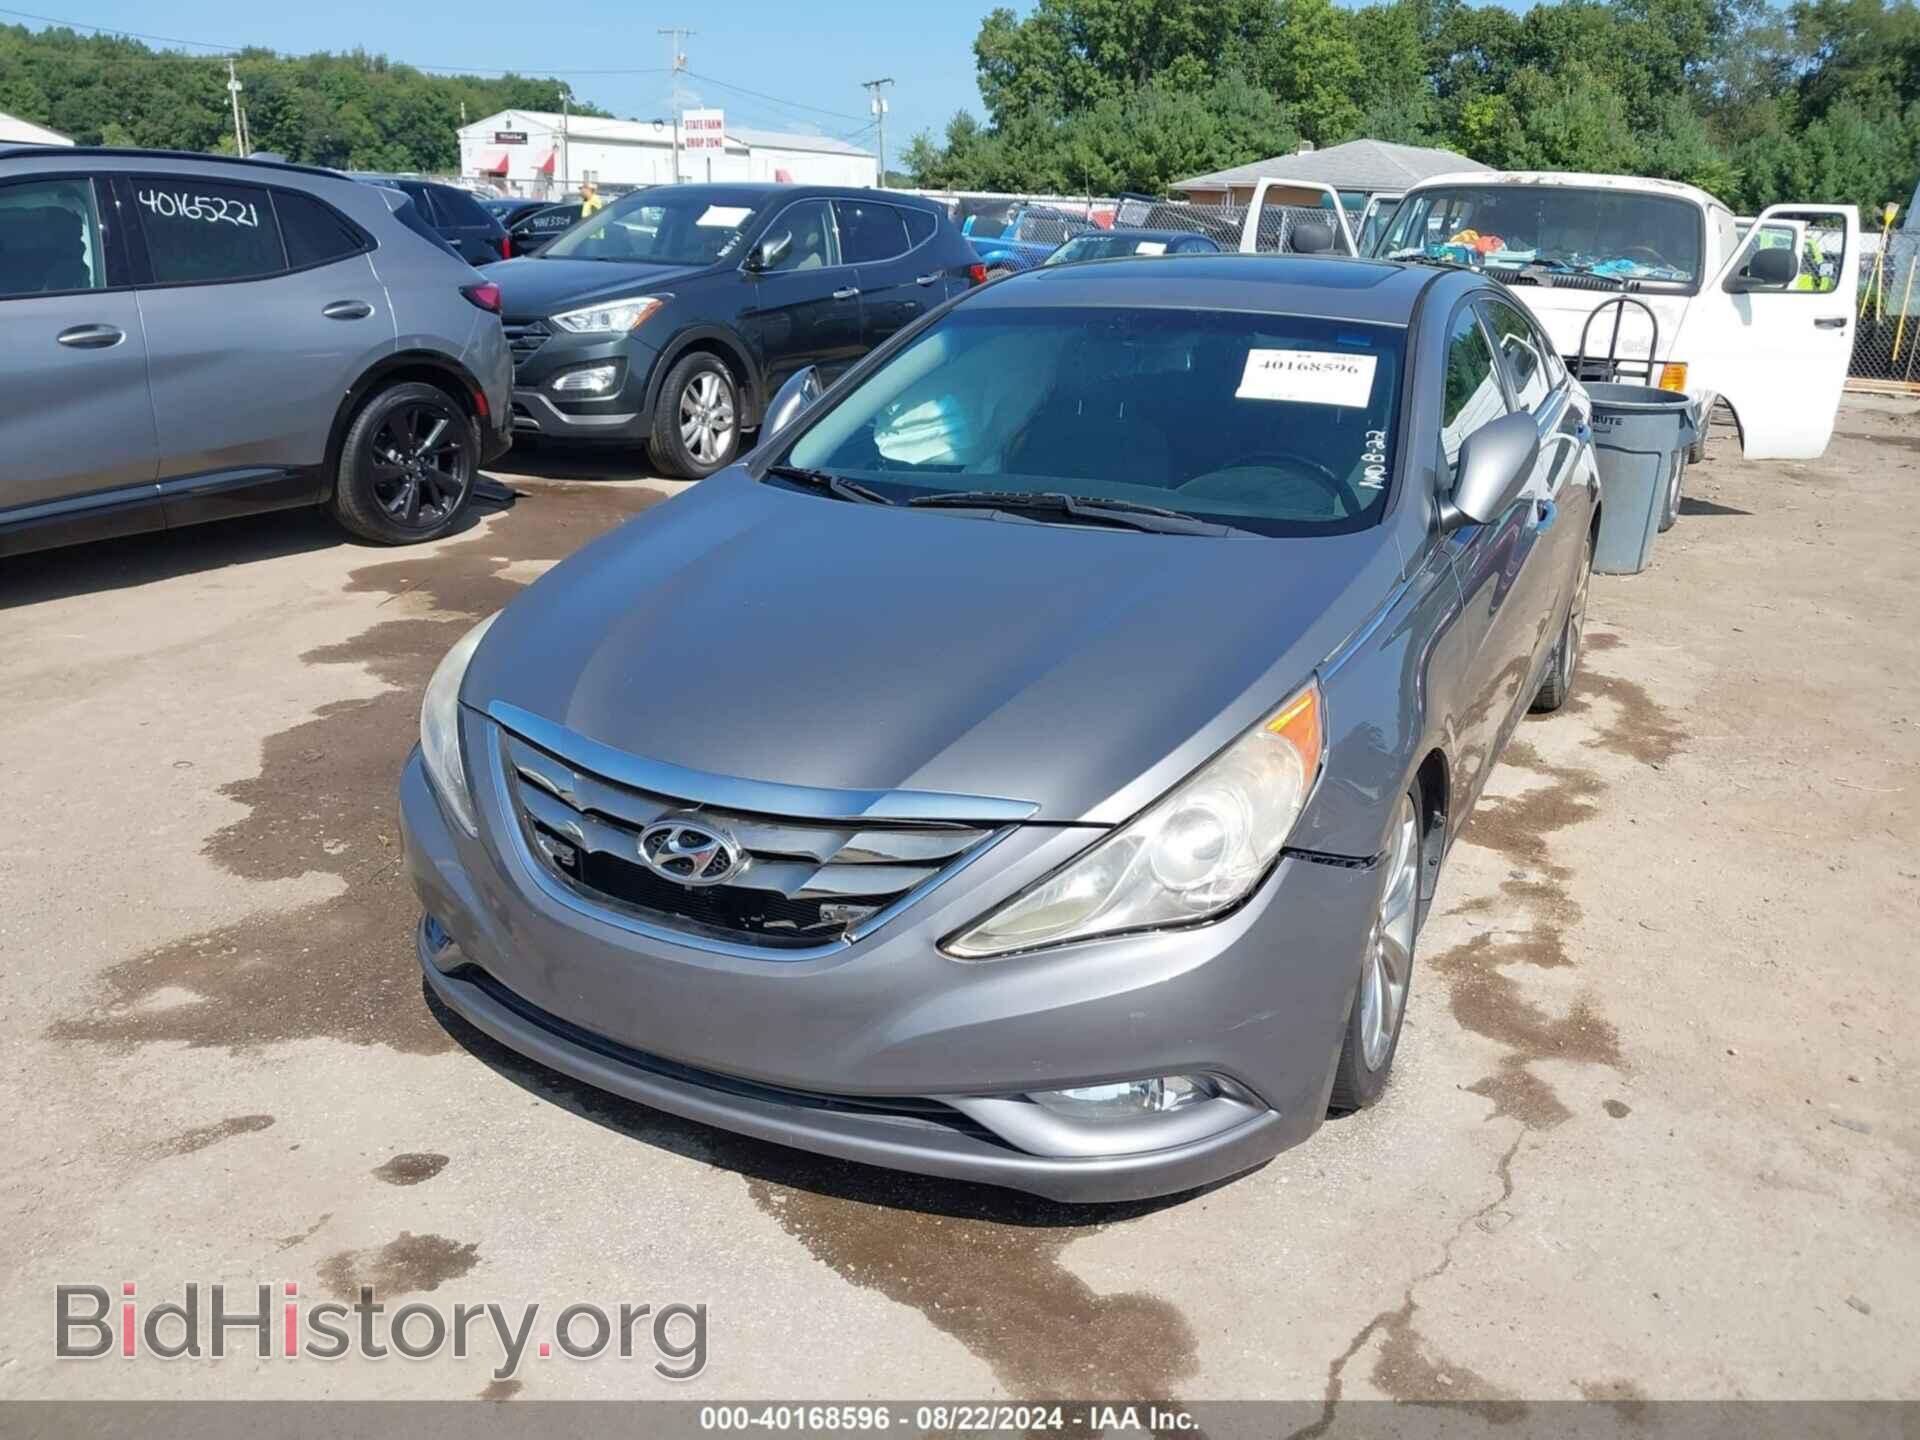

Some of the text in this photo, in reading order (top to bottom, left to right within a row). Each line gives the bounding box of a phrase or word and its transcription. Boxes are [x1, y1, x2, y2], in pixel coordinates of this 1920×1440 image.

[685, 119, 722, 130] STATE FARM
[138, 188, 259, 228] 40165221
[1258, 360, 1358, 375] 40168596
[1592, 415, 1624, 426] RUTE
